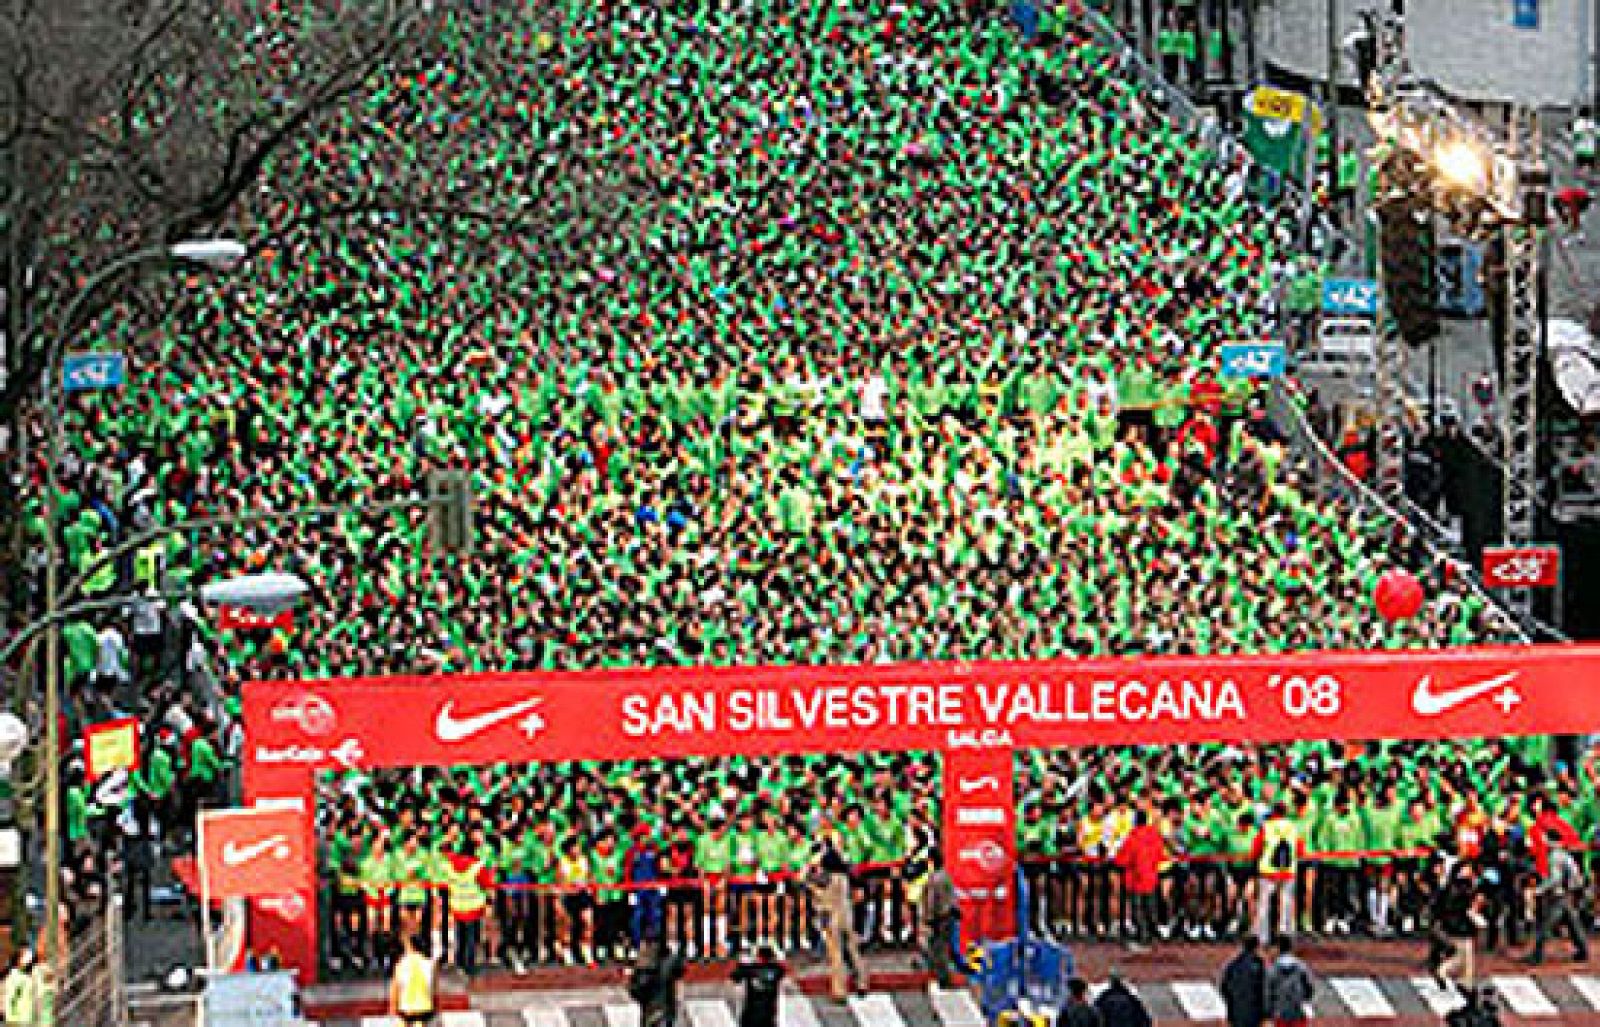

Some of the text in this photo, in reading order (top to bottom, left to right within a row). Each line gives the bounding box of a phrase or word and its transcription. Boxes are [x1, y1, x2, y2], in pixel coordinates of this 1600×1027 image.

[622, 693, 716, 735] SAN
[728, 685, 964, 730] SILVESTRE
[974, 680, 1246, 722] VALLECANA
